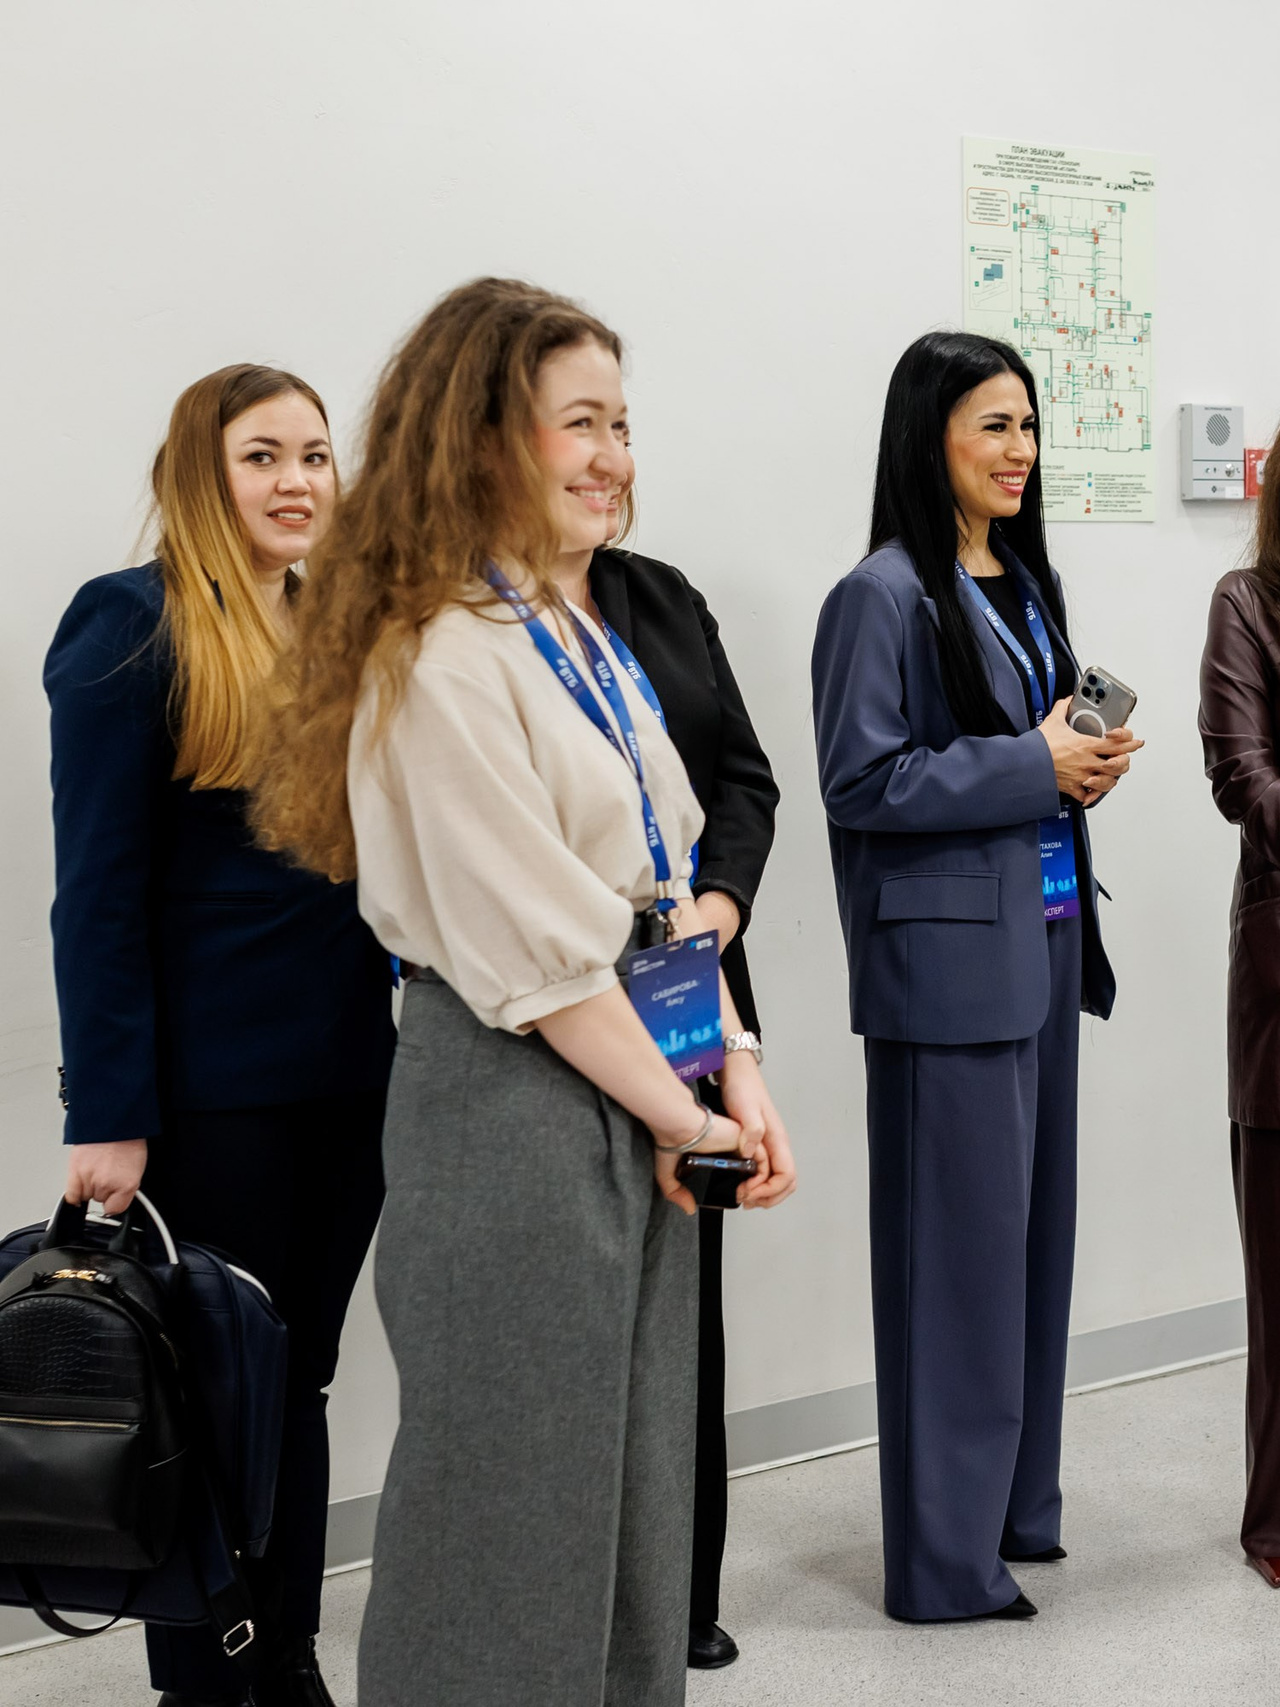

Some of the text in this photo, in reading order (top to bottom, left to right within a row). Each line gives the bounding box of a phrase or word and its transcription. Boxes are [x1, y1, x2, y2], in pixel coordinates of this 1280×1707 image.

[985, 607, 997, 621] ВТБ
[1026, 606, 1036, 621] ВТБ
[1020, 654, 1031, 668] ВТБ
[594, 660, 612, 679] ВТБ
[627, 667, 641, 680] ВТБ
[558, 666, 579, 689] ВТБ
[1058, 810, 1069, 819] ВТБ
[647, 826, 659, 848] ВТБ
[696, 938, 713, 950] ВТБ
